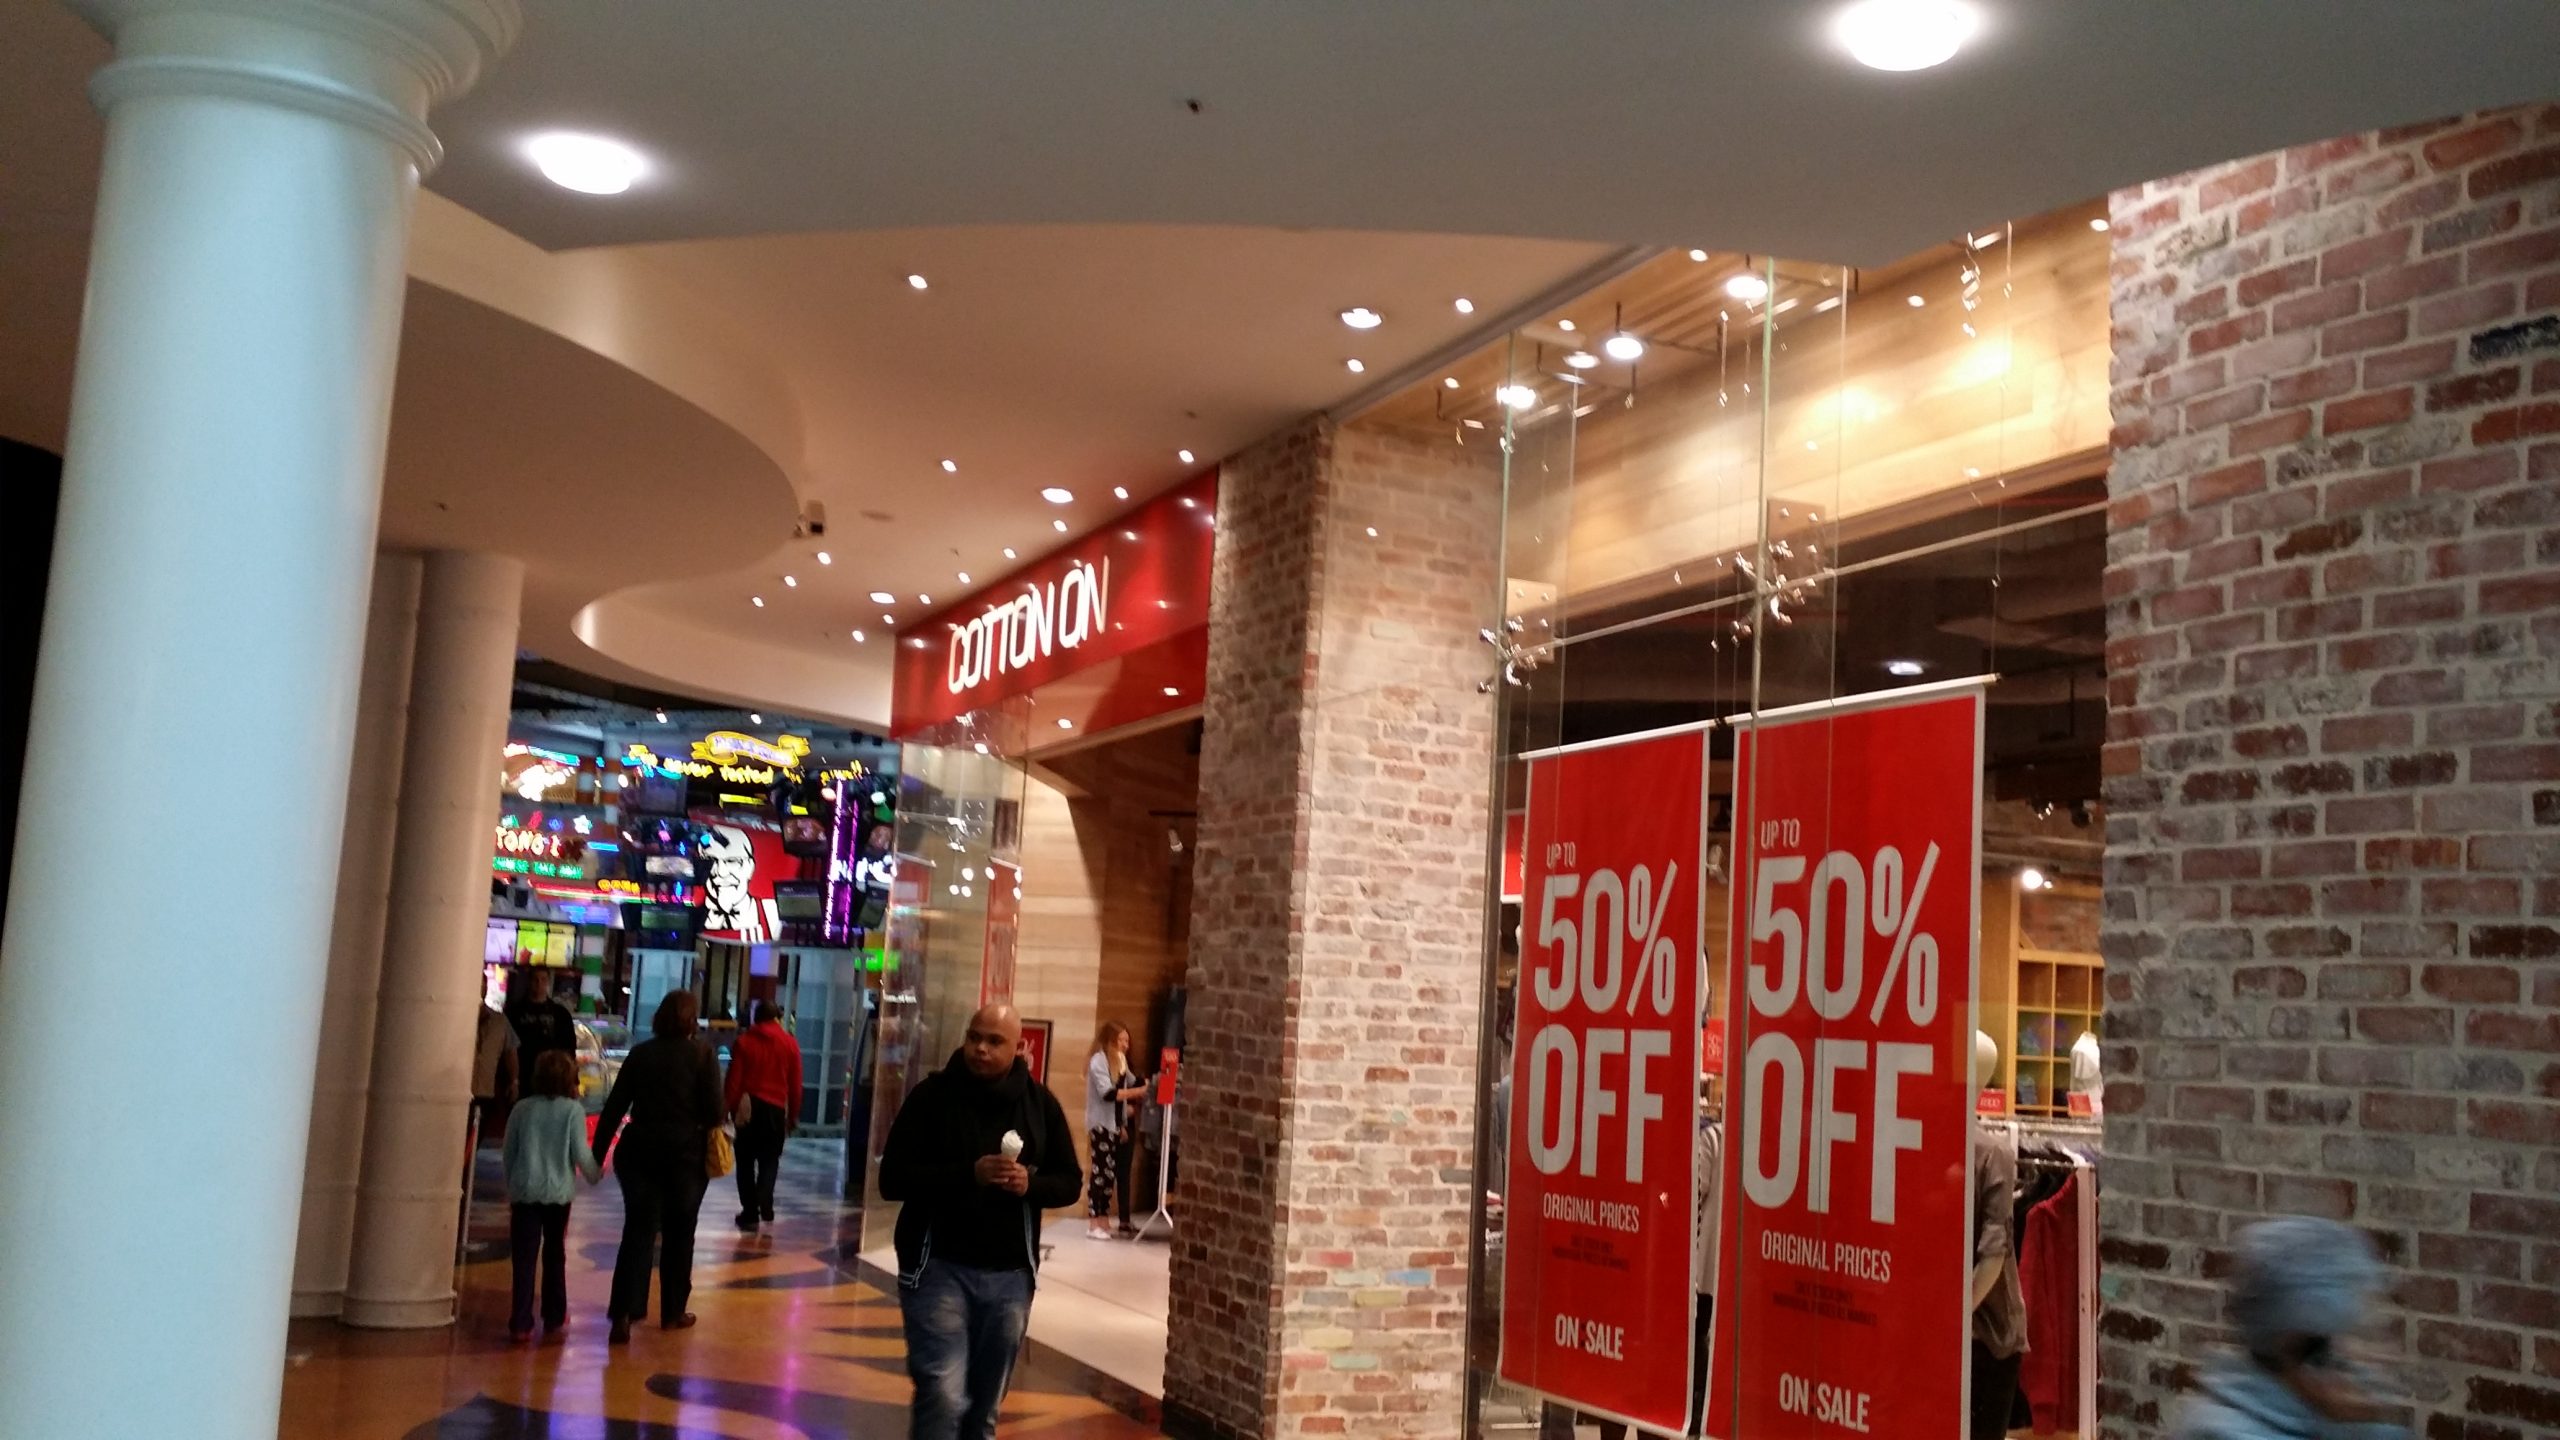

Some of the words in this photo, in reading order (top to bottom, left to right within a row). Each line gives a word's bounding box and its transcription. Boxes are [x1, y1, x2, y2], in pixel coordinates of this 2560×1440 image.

[949, 582, 1054, 693] COTTON
[1059, 556, 1108, 648] ON
[1547, 843, 1560, 869] UP
[1563, 842, 1575, 867] TO
[1761, 820, 1779, 849] UP
[1782, 819, 1800, 847] TO
[1535, 859, 1677, 1016] 50%
[1748, 839, 1939, 1026] 50%
[1528, 1024, 1670, 1182] OFF
[1743, 1032, 1933, 1224] OFF
[1544, 1193, 1596, 1225] ORIGINAL
[1600, 1202, 1639, 1232] PRICES
[1762, 1230, 1829, 1270] ORIGINAL
[1835, 1243, 1891, 1282] PRICES
[1556, 1314, 1579, 1348] ON
[1585, 1321, 1624, 1360] SALE
[1780, 1373, 1808, 1414] ON
[1817, 1383, 1870, 1432] SALE
